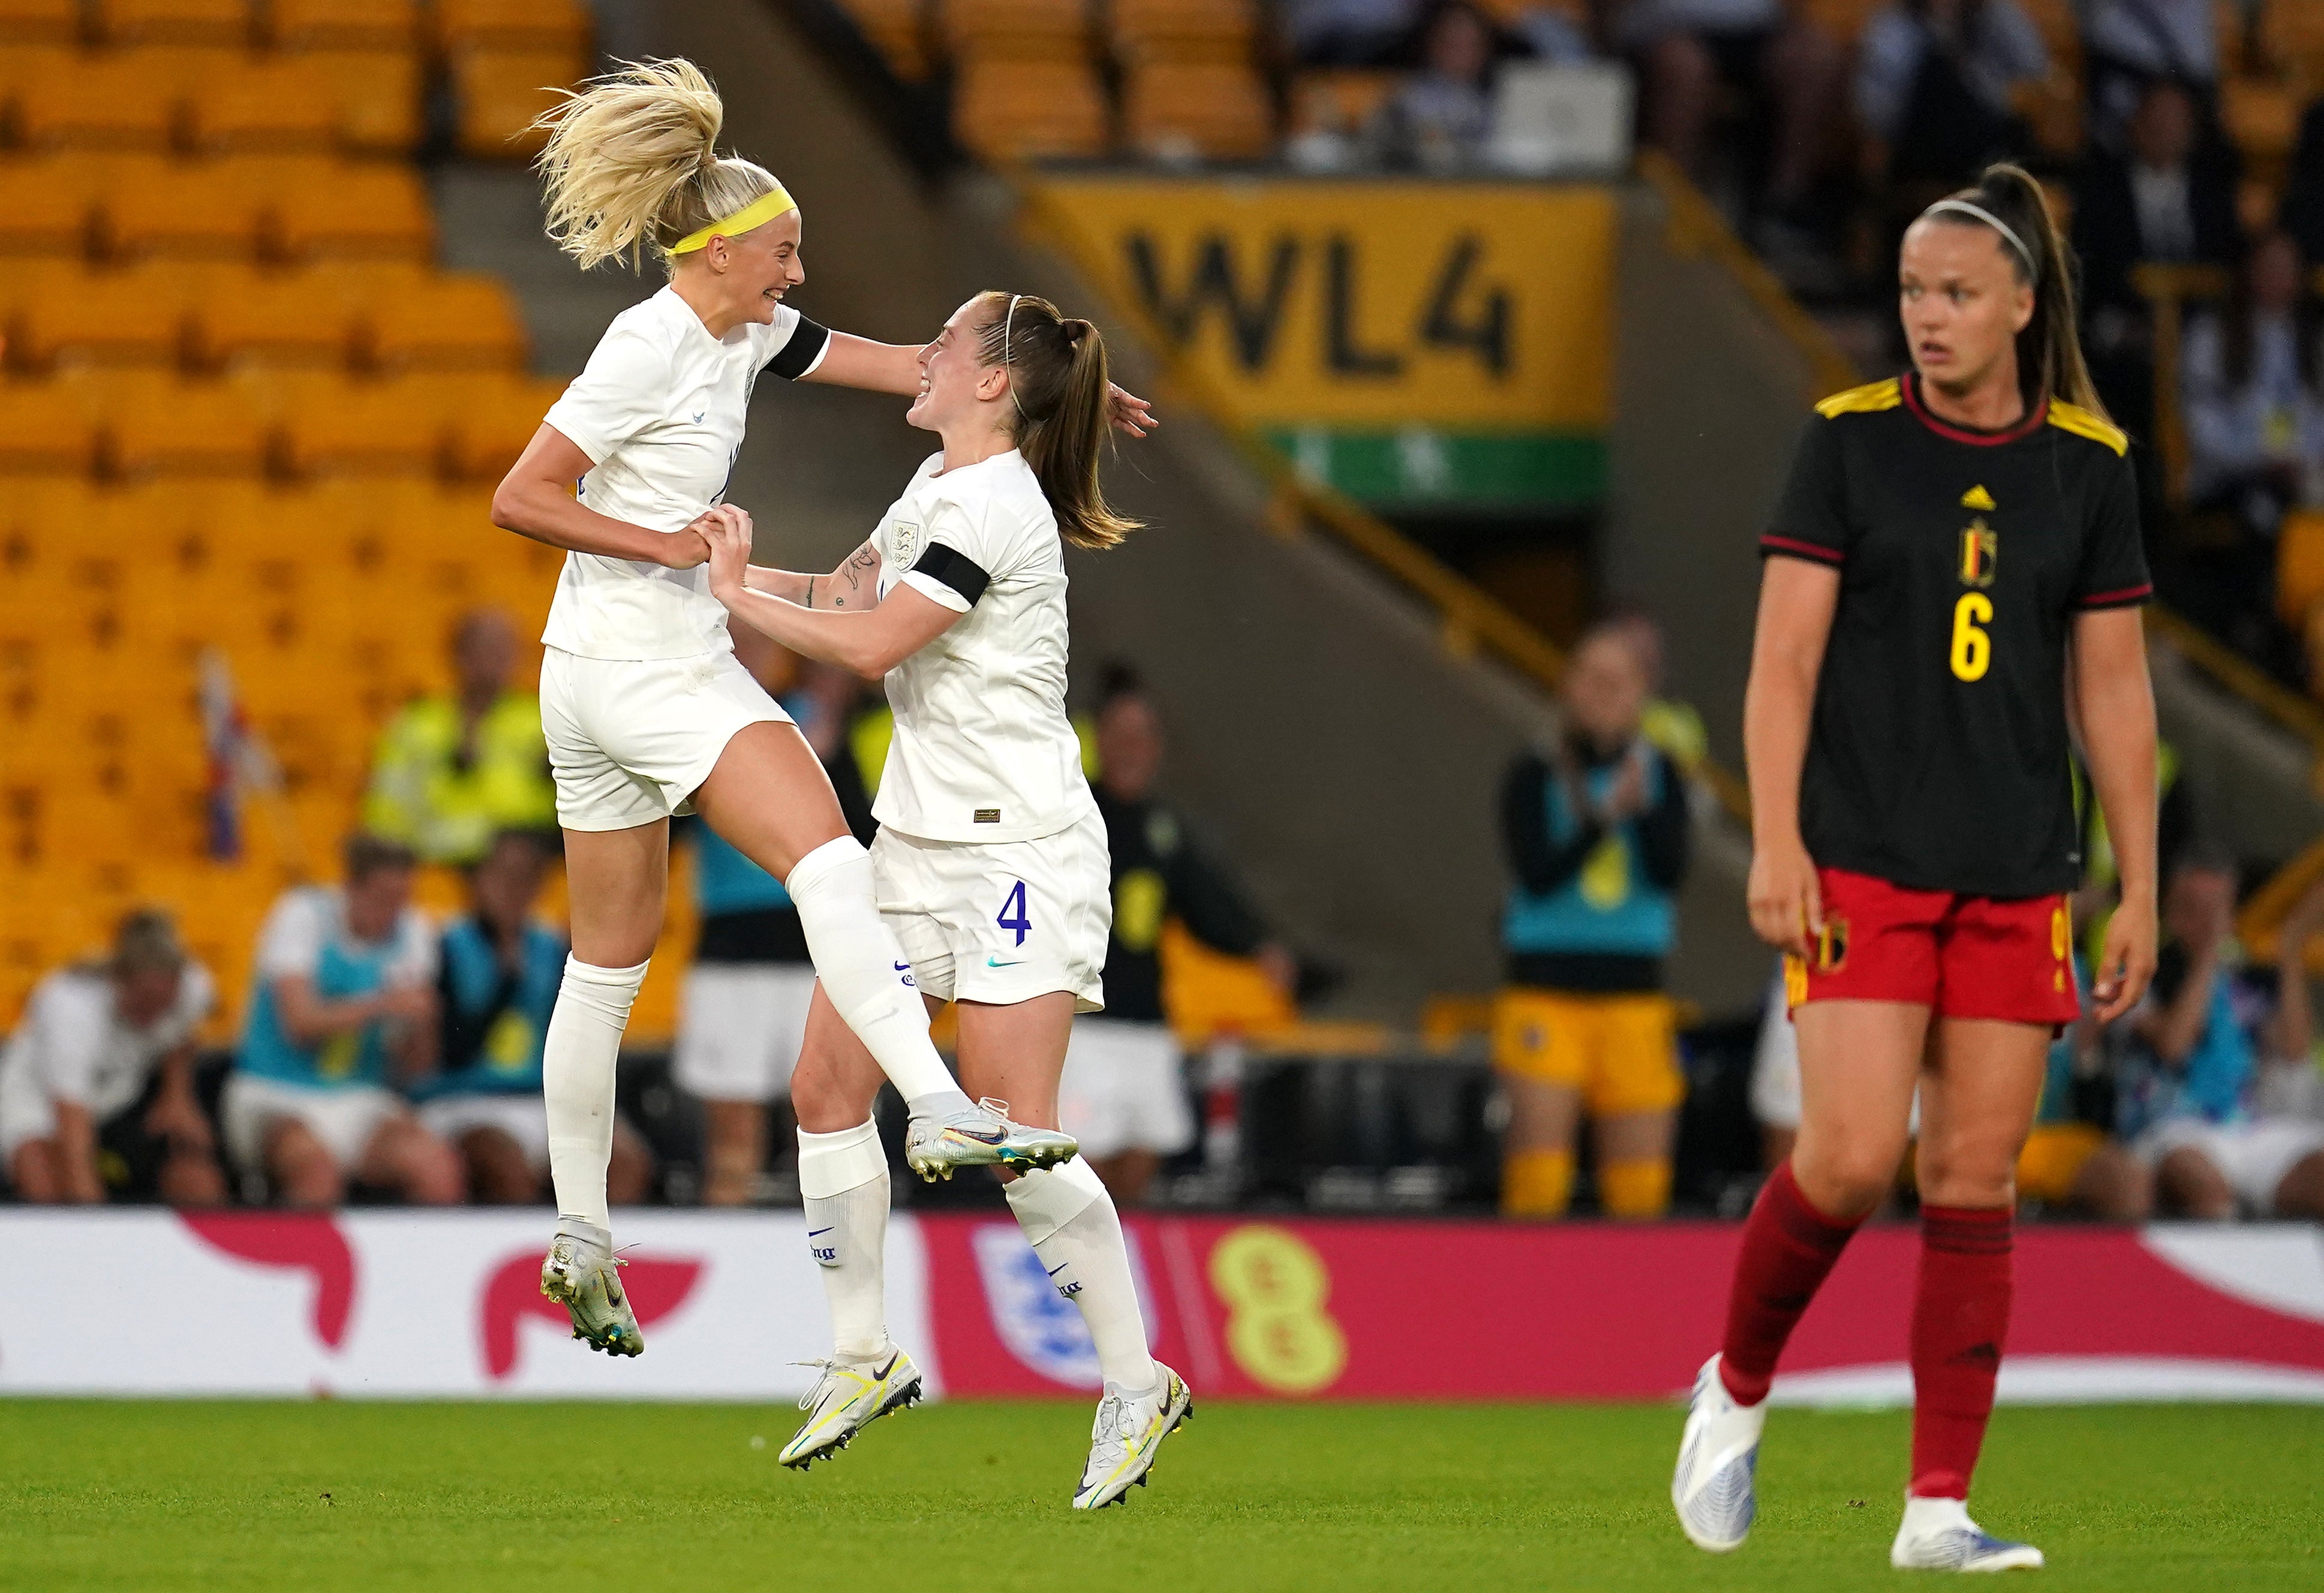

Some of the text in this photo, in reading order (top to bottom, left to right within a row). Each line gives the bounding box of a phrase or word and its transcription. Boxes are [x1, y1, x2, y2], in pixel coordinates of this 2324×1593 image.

[1123, 230, 1513, 383] WL4
[1950, 591, 1994, 683] 6
[996, 879, 1033, 948] 4
[810, 1245, 836, 1261] ng
